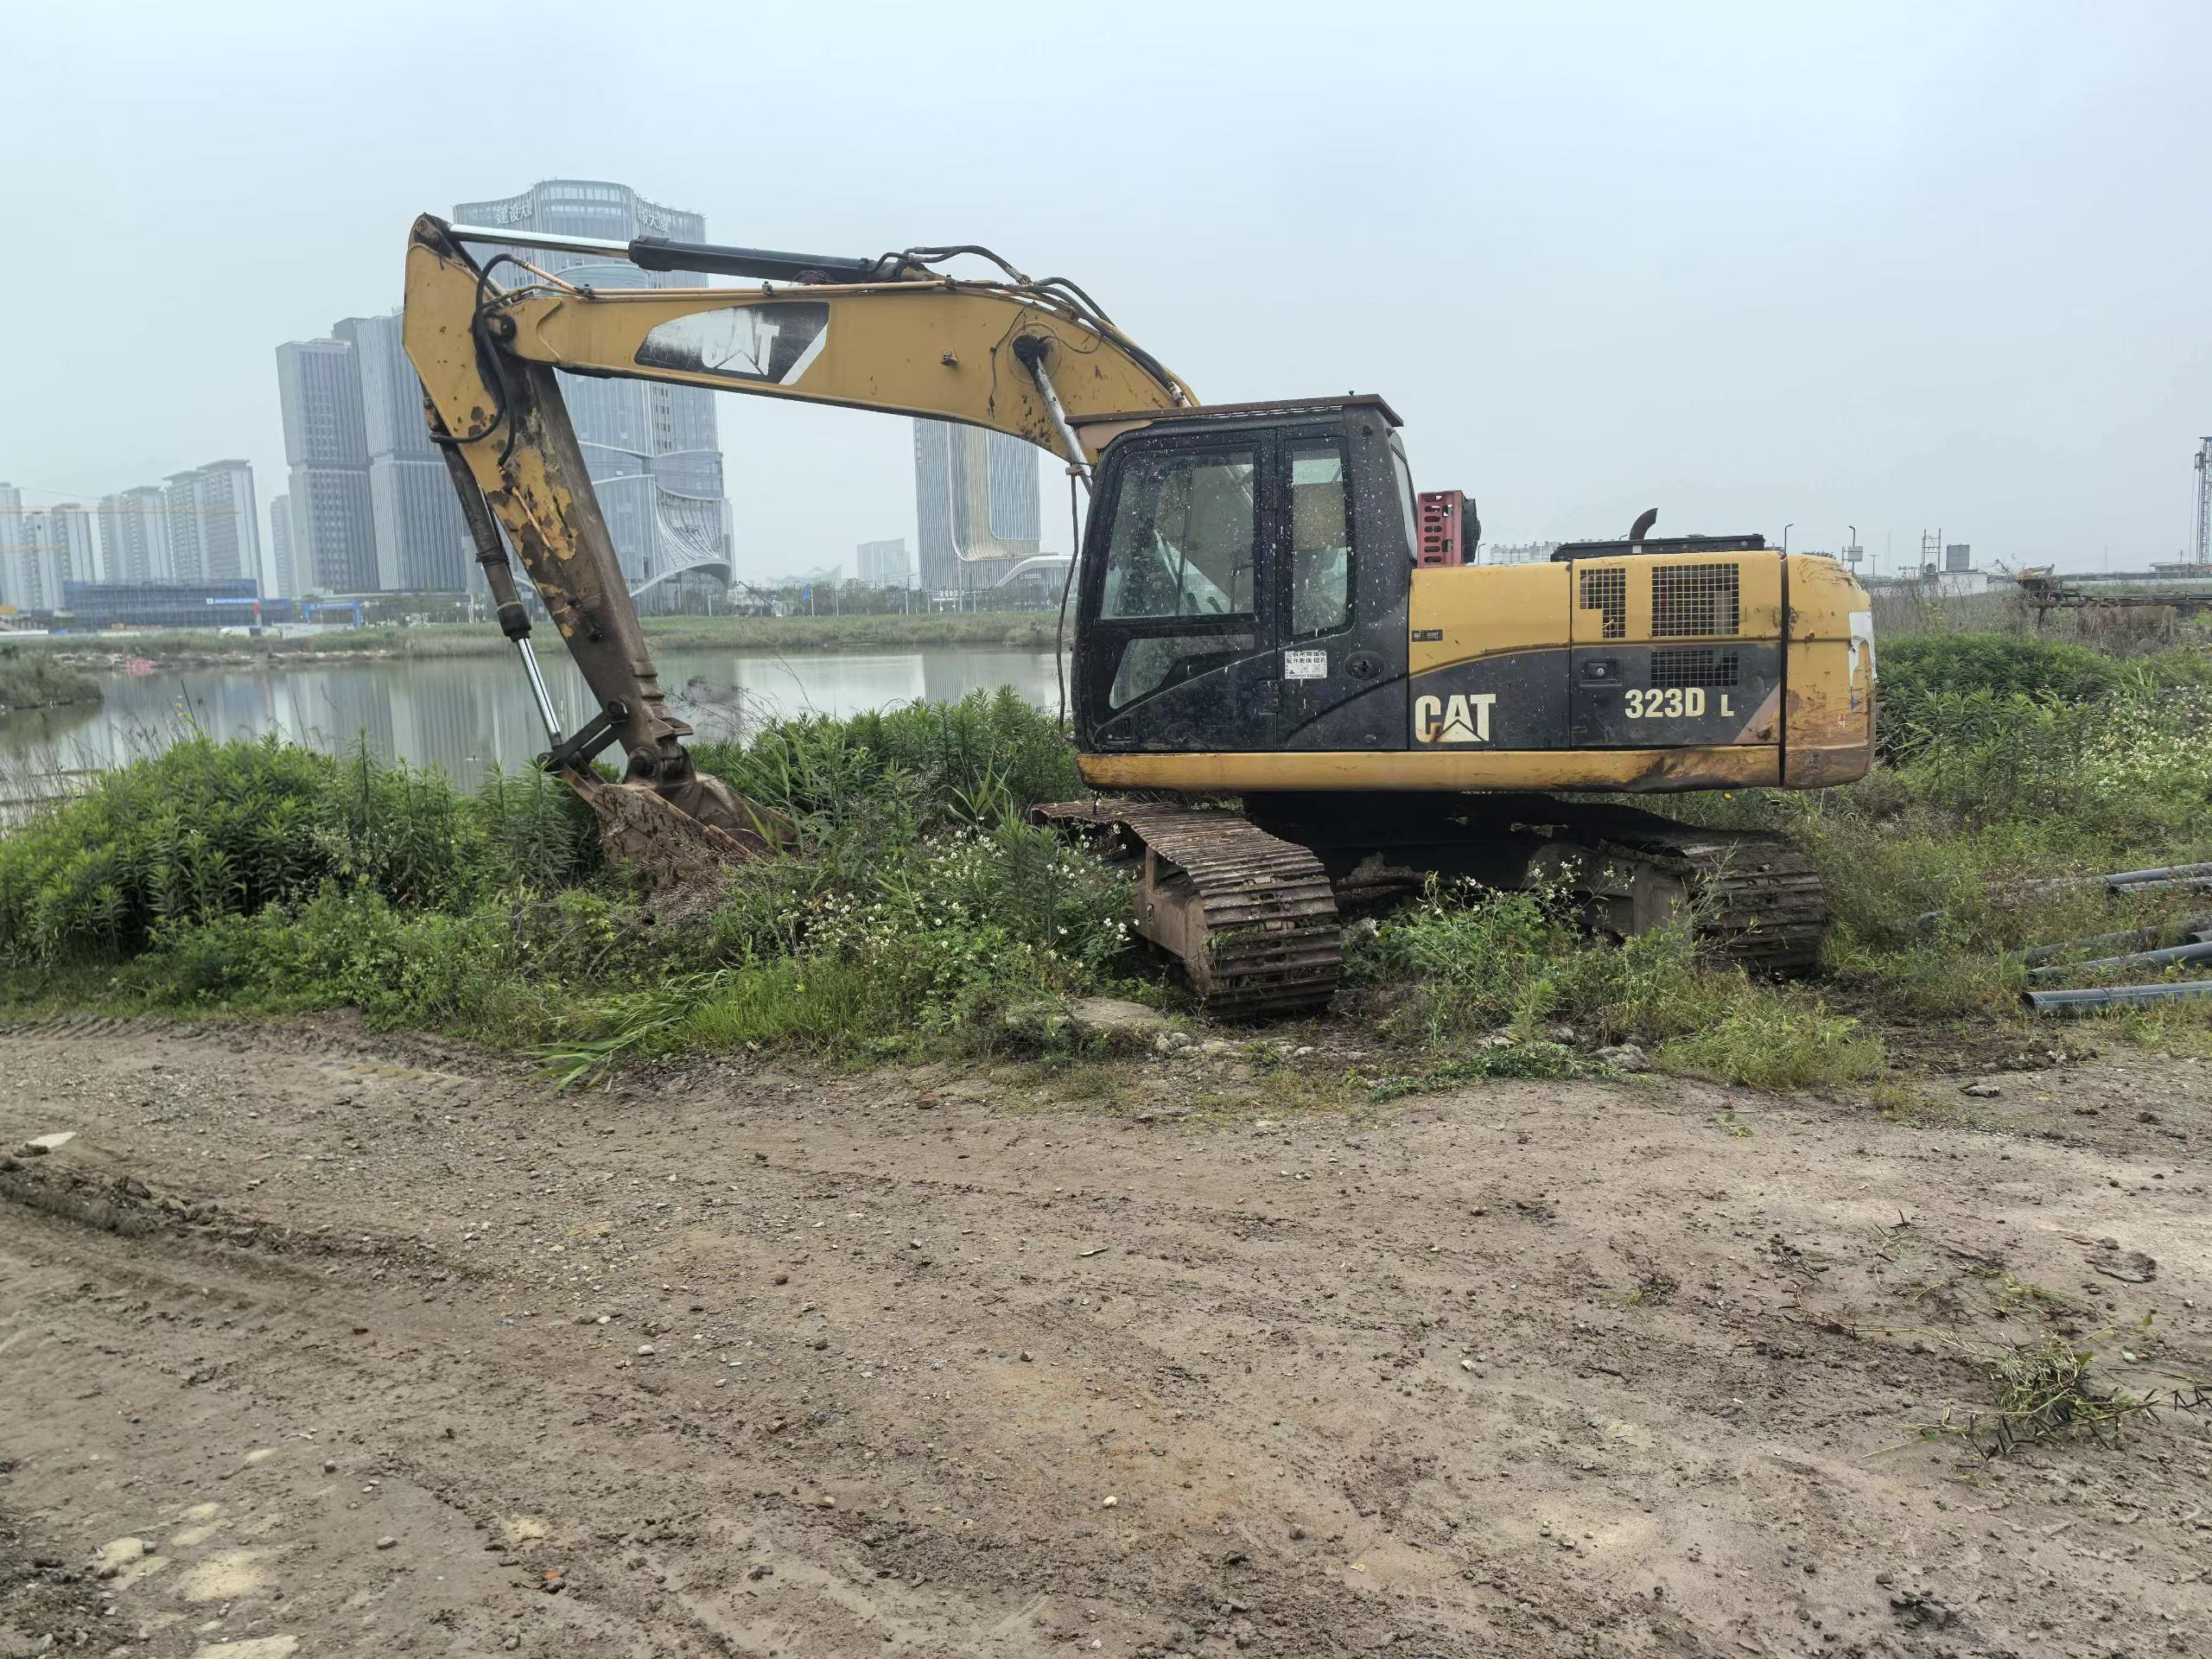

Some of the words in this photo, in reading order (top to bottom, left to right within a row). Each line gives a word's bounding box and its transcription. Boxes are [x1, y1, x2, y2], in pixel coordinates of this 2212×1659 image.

[1414, 694, 1497, 743] CAT
[1624, 687, 1706, 719] 323D
[1720, 694, 1734, 717] L
